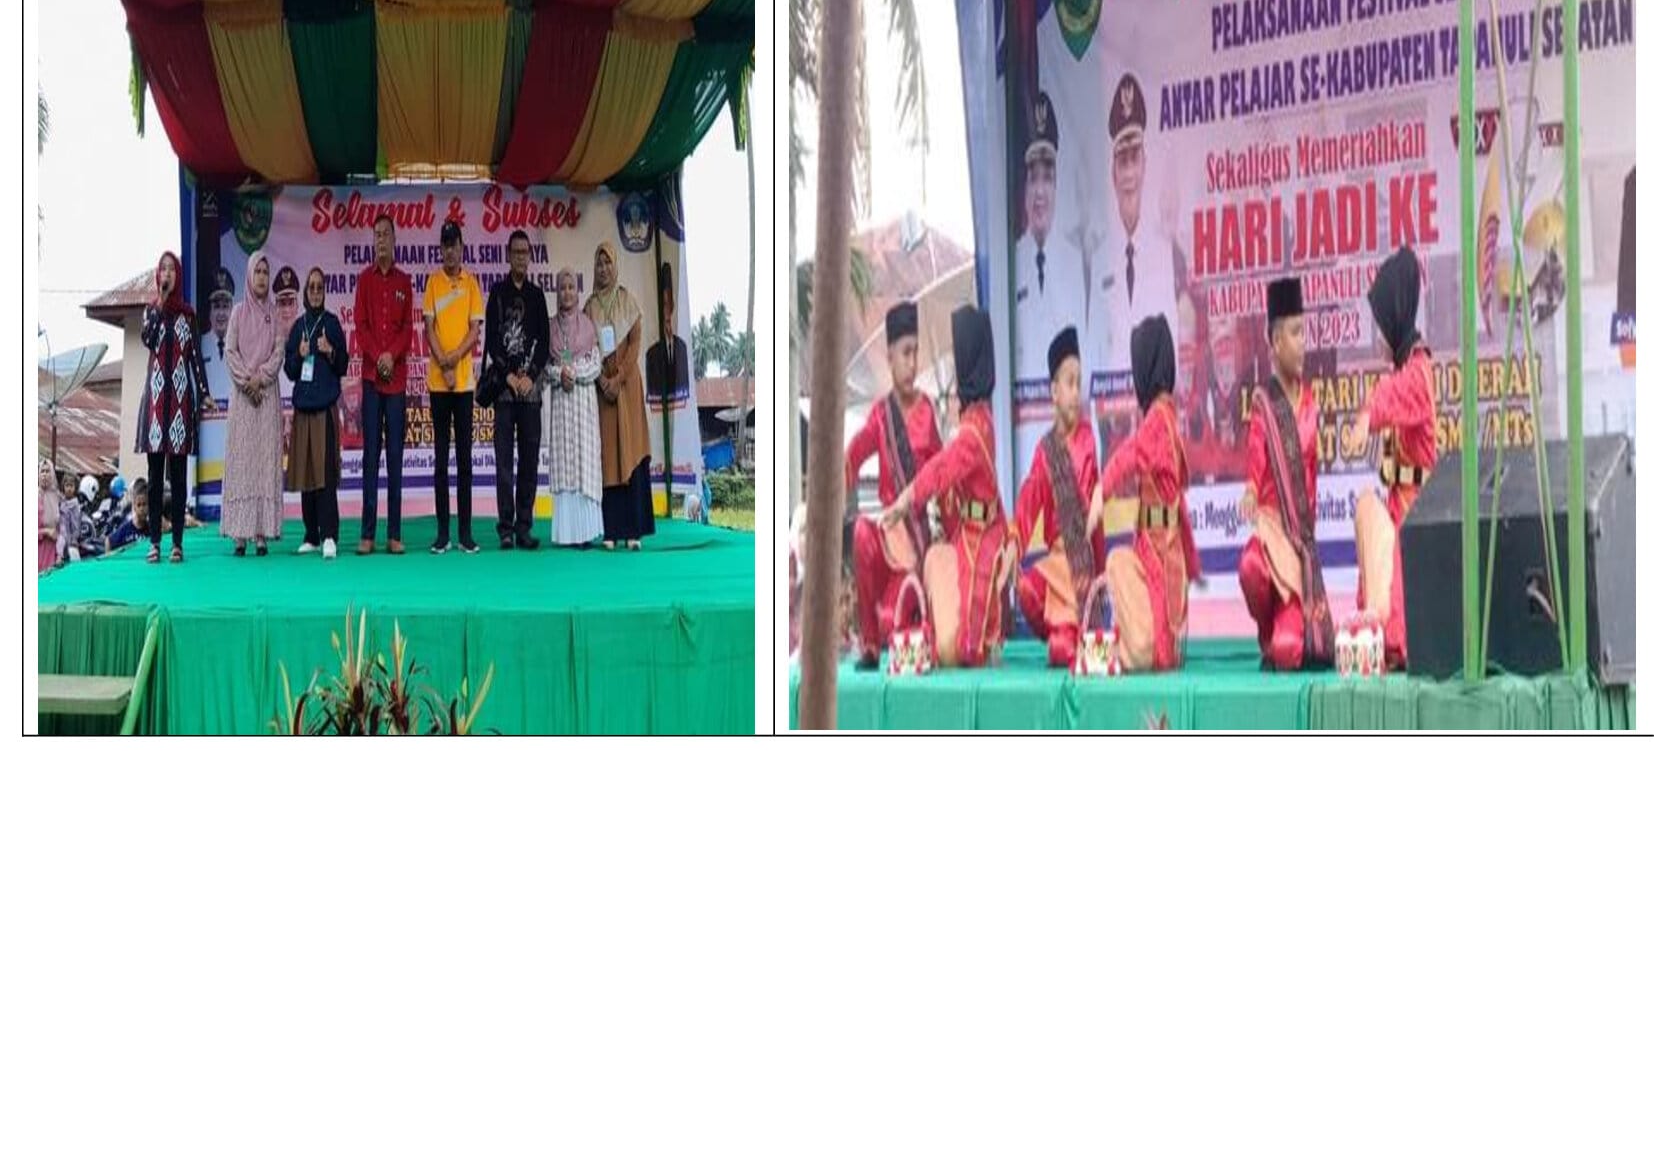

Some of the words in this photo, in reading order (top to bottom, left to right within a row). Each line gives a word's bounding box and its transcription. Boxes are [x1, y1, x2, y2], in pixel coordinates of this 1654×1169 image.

[1160, 78, 1216, 132] ANTAR
[1220, 59, 1296, 119] PELAJAR
[1300, 29, 1436, 103] SE-KABUPATEN
[1439, 10, 1536, 76] TAANULI
[1206, 142, 1292, 193] Sekaligus
[1296, 120, 1426, 179] Memeriahkan
[312, 188, 436, 233] Selamat
[482, 184, 581, 232] Sukses
[1193, 196, 1283, 276] HARI
[1293, 178, 1377, 263] JADI
[1389, 173, 1439, 248] KE
[344, 244, 426, 265] PELANAAN
[479, 244, 502, 264] SENI
[1303, 265, 1361, 306] APANULI
[1320, 313, 1360, 344] 2023
[1448, 355, 1542, 402] DERAH
[1438, 417, 1463, 451] SM
